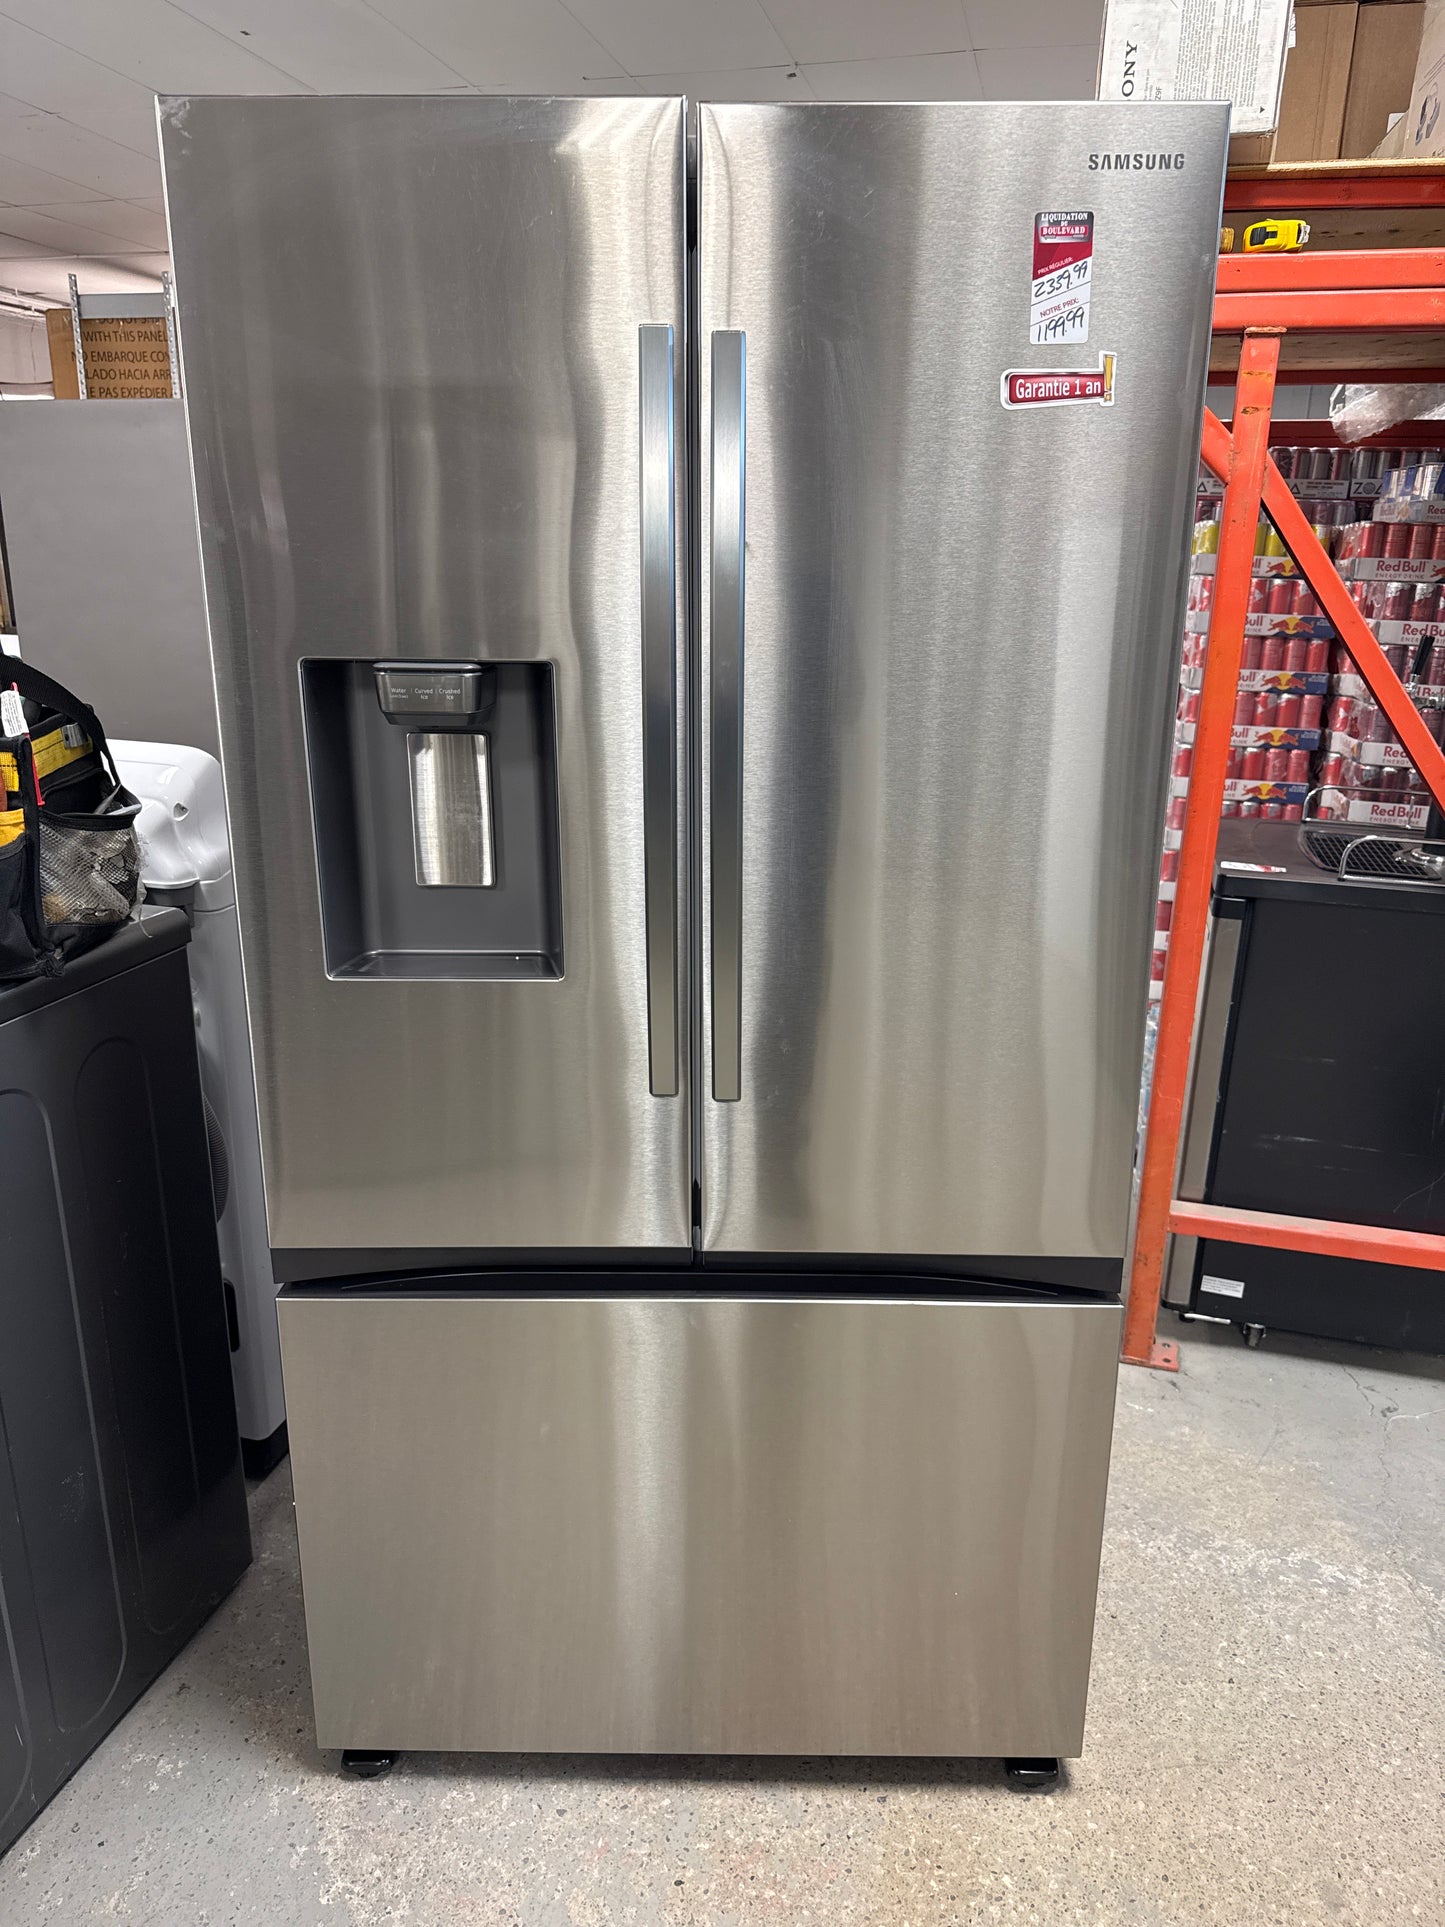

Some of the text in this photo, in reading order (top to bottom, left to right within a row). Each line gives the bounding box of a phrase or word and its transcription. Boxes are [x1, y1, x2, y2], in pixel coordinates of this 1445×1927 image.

[1122, 40, 1137, 100] ONY
[1088, 153, 1185, 171] SAMSUNG
[1041, 212, 1088, 222] LIQUIDATION
[1042, 226, 1086, 235] BOULEVARD
[1038, 266, 1049, 275] PRIX
[1040, 297, 1080, 318] NOTRE PRIX:
[83, 331, 111, 342] WITH
[112, 331, 135, 342] THIS
[91, 351, 149, 363] EMBARQUE
[120, 369, 150, 380] HACIA
[99, 387, 119, 398] PAS
[121, 385, 168, 398] EXPÉDIER
[1016, 378, 1070, 398] Garantie
[1074, 379, 1081, 395] 1
[1376, 560, 1426, 572] Red Bull
[1402, 623, 1445, 637] Red Bu
[438, 687, 461, 695] Crushed
[1224, 781, 1237, 792] ull
[1370, 804, 1396, 816] Red
